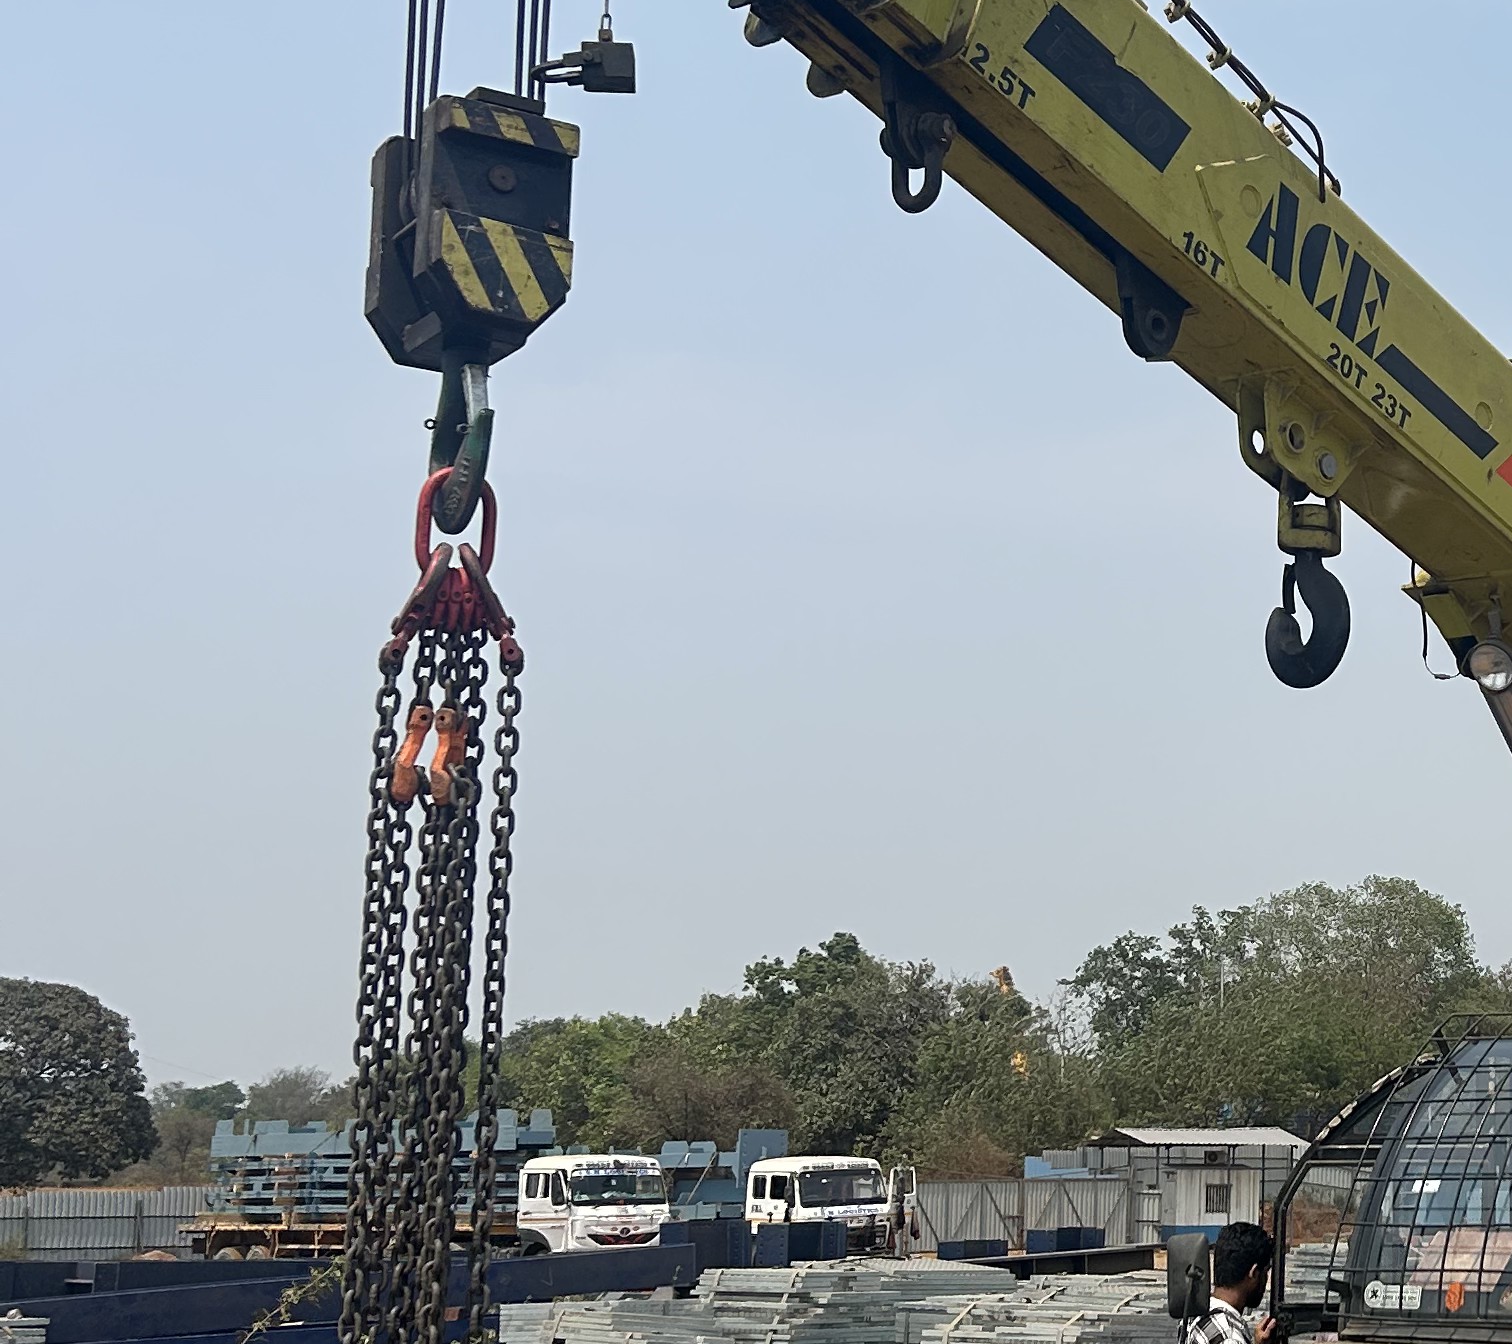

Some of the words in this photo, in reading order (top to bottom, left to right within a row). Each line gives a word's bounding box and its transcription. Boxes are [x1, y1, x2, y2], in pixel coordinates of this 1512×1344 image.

[969, 43, 1036, 110] 2.5T
[1182, 230, 1226, 280] 16T
[1245, 181, 1391, 359] ACE
[1325, 342, 1369, 392] 20T
[1371, 382, 1413, 430] 23T
